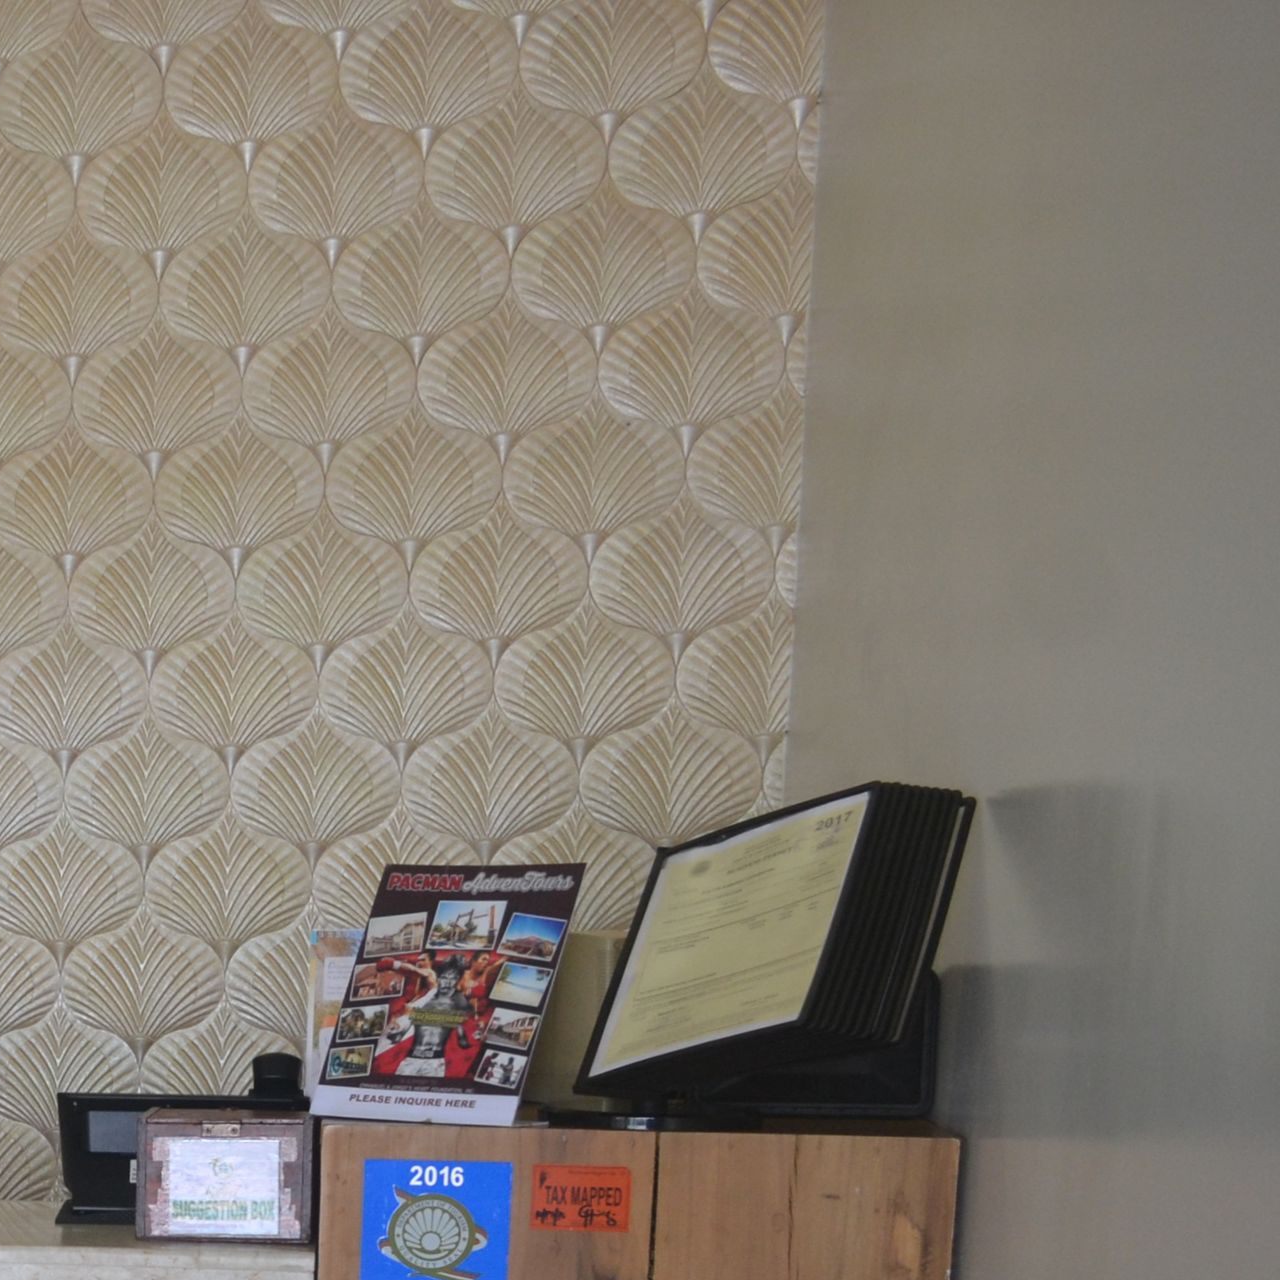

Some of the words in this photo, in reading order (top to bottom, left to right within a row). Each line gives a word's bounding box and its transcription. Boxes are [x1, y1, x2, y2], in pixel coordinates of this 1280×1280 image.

[815, 810, 853, 831] 2017
[387, 872, 464, 892] PACMAN
[463, 871, 575, 895] AdvenTours
[349, 1093, 392, 1104] PLEASE
[394, 1096, 442, 1107] INQUIRE
[444, 1098, 477, 1109] HERE
[409, 1165, 464, 1187] 2016
[545, 1186, 567, 1205] TAX
[571, 1187, 622, 1207] MAPPED
[171, 1200, 247, 1220] SUGGESTION
[251, 1200, 275, 1220] BOX
